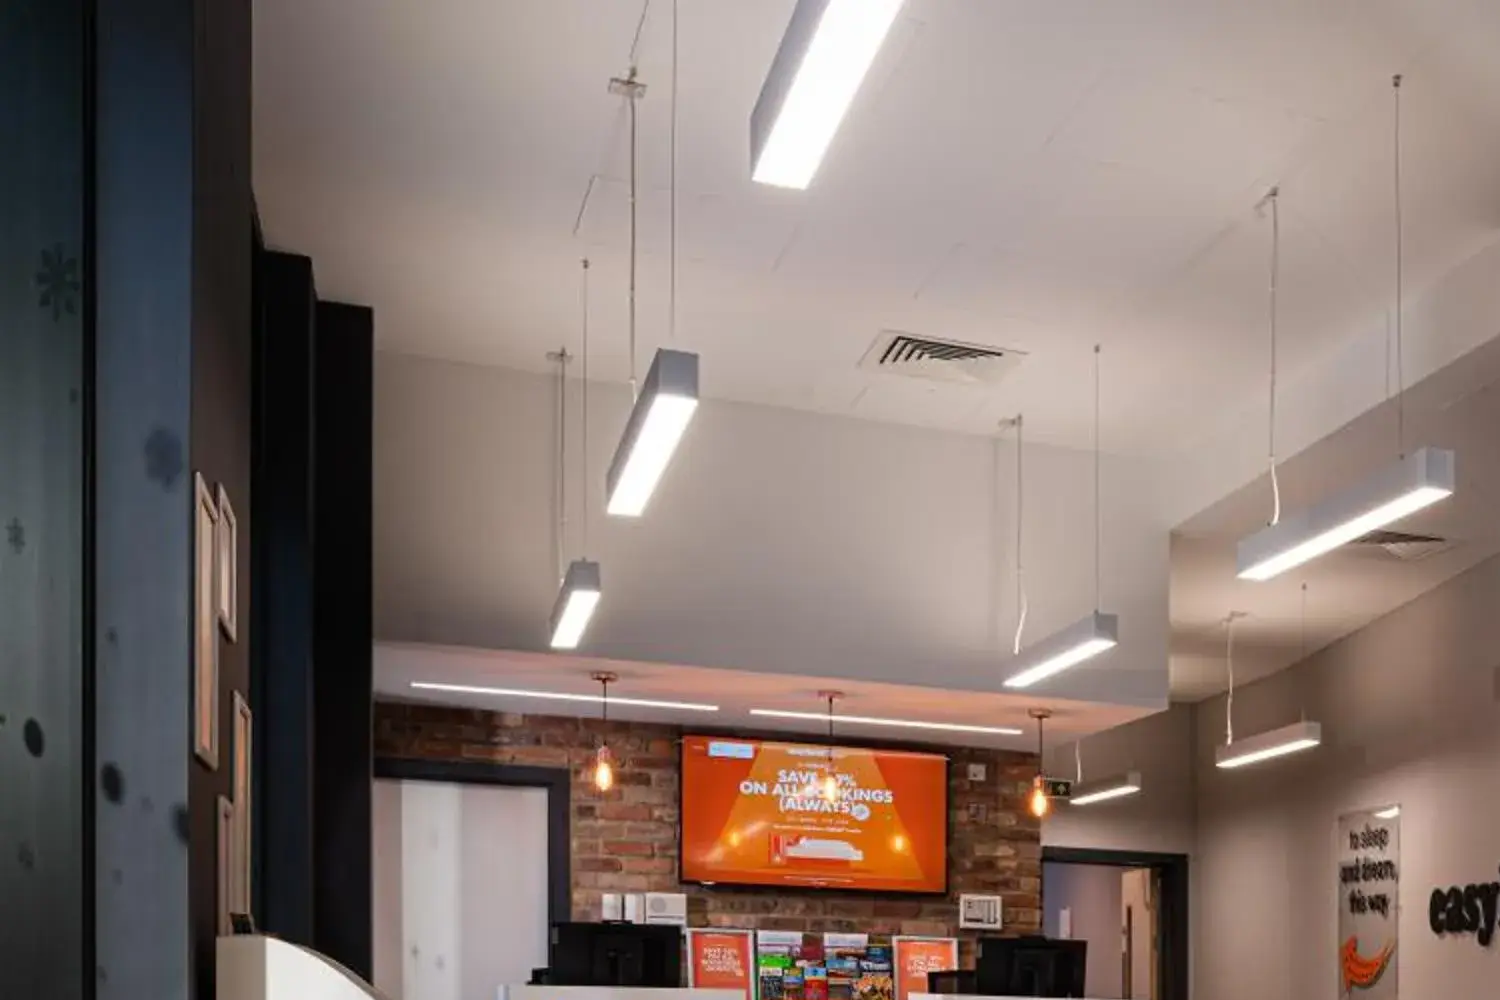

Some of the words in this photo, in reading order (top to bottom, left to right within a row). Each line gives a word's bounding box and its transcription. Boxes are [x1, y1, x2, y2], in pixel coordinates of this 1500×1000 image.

[778, 768, 818, 784] SAVE
[739, 780, 767, 795] ON
[772, 782, 801, 796] ALL
